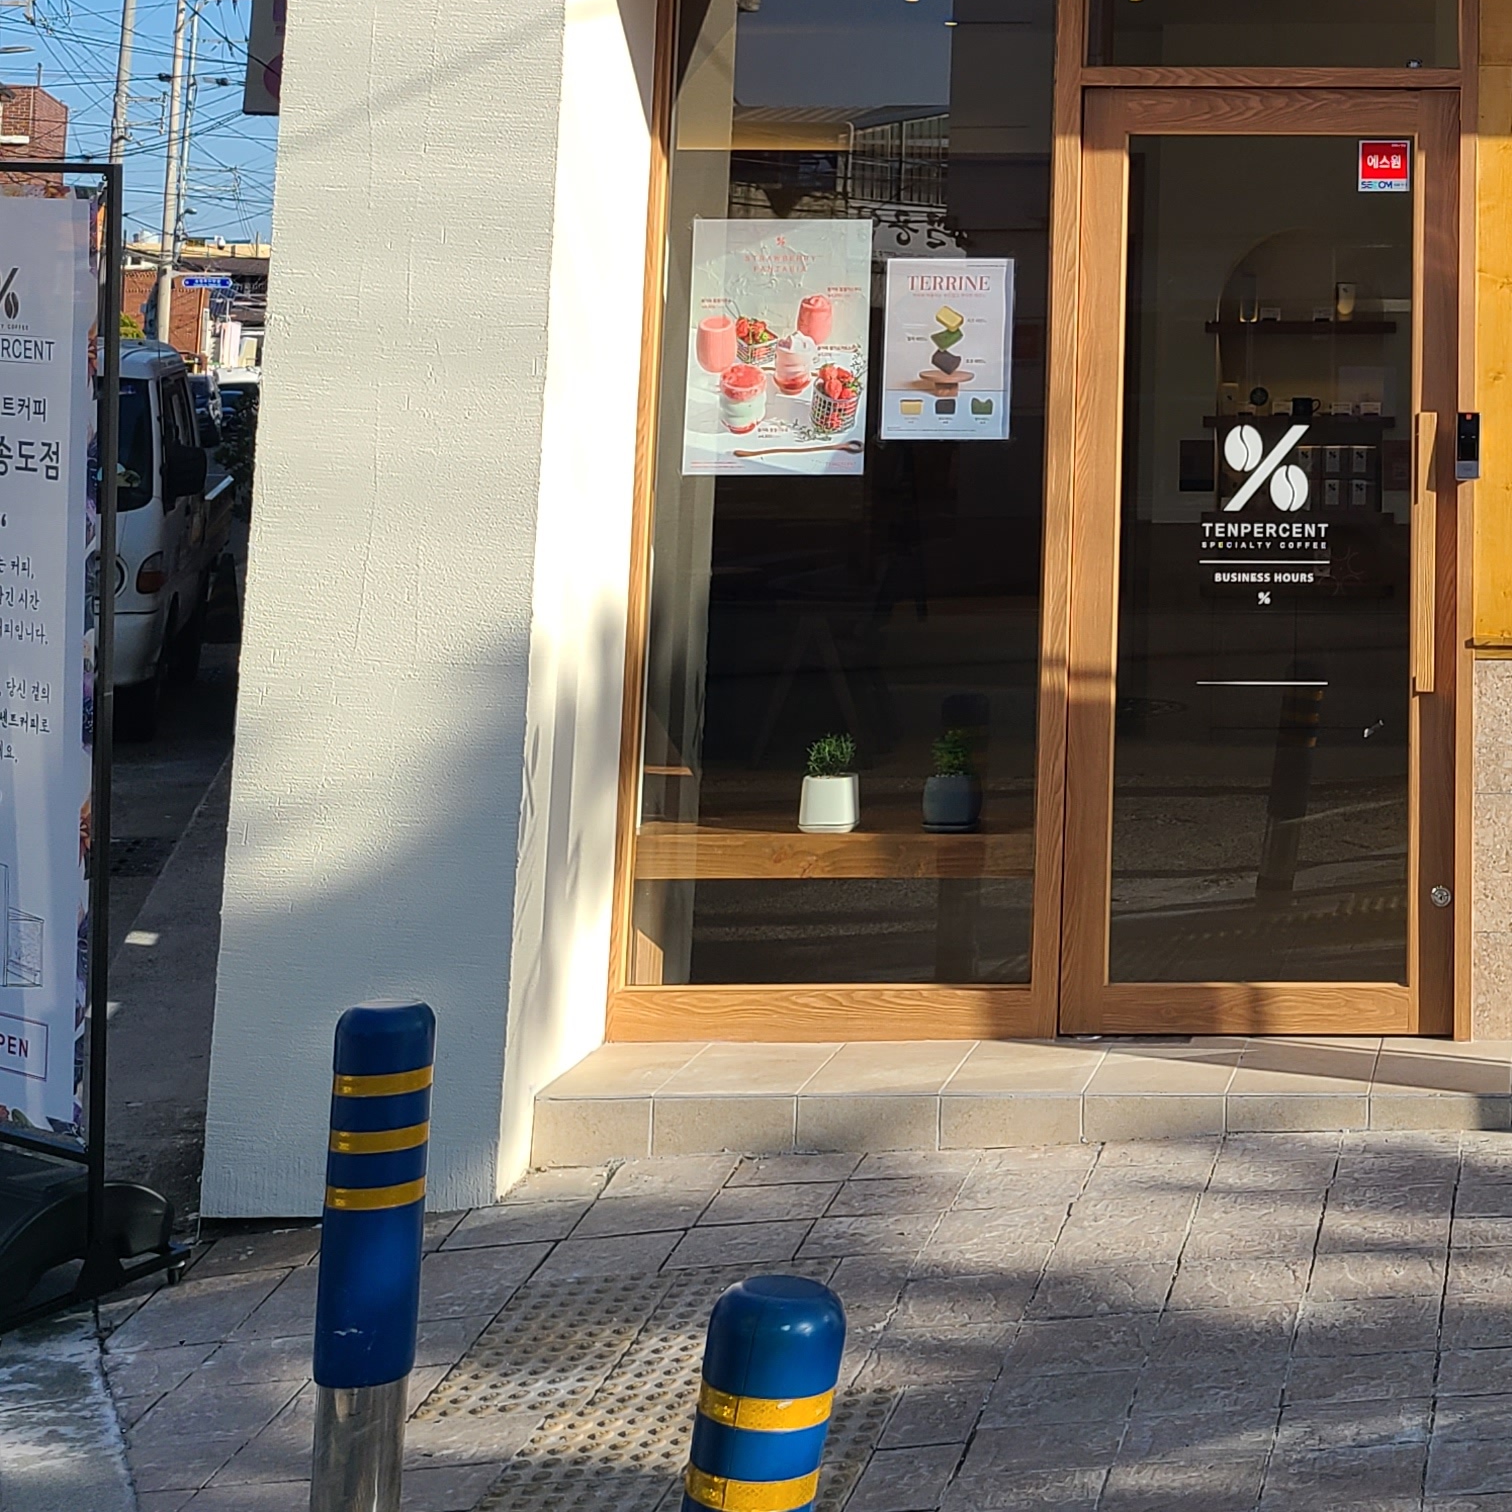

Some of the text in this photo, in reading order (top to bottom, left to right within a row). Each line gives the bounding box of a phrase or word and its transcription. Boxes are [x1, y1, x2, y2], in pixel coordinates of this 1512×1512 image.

[1367, 154, 1401, 169] 에스원
[907, 275, 990, 291] TERRINE
[1202, 523, 1329, 537] TENPERCENT
[1202, 541, 1327, 549] SPECIALTY COFFEE
[1214, 572, 1314, 583] BUSINESS HOURS
